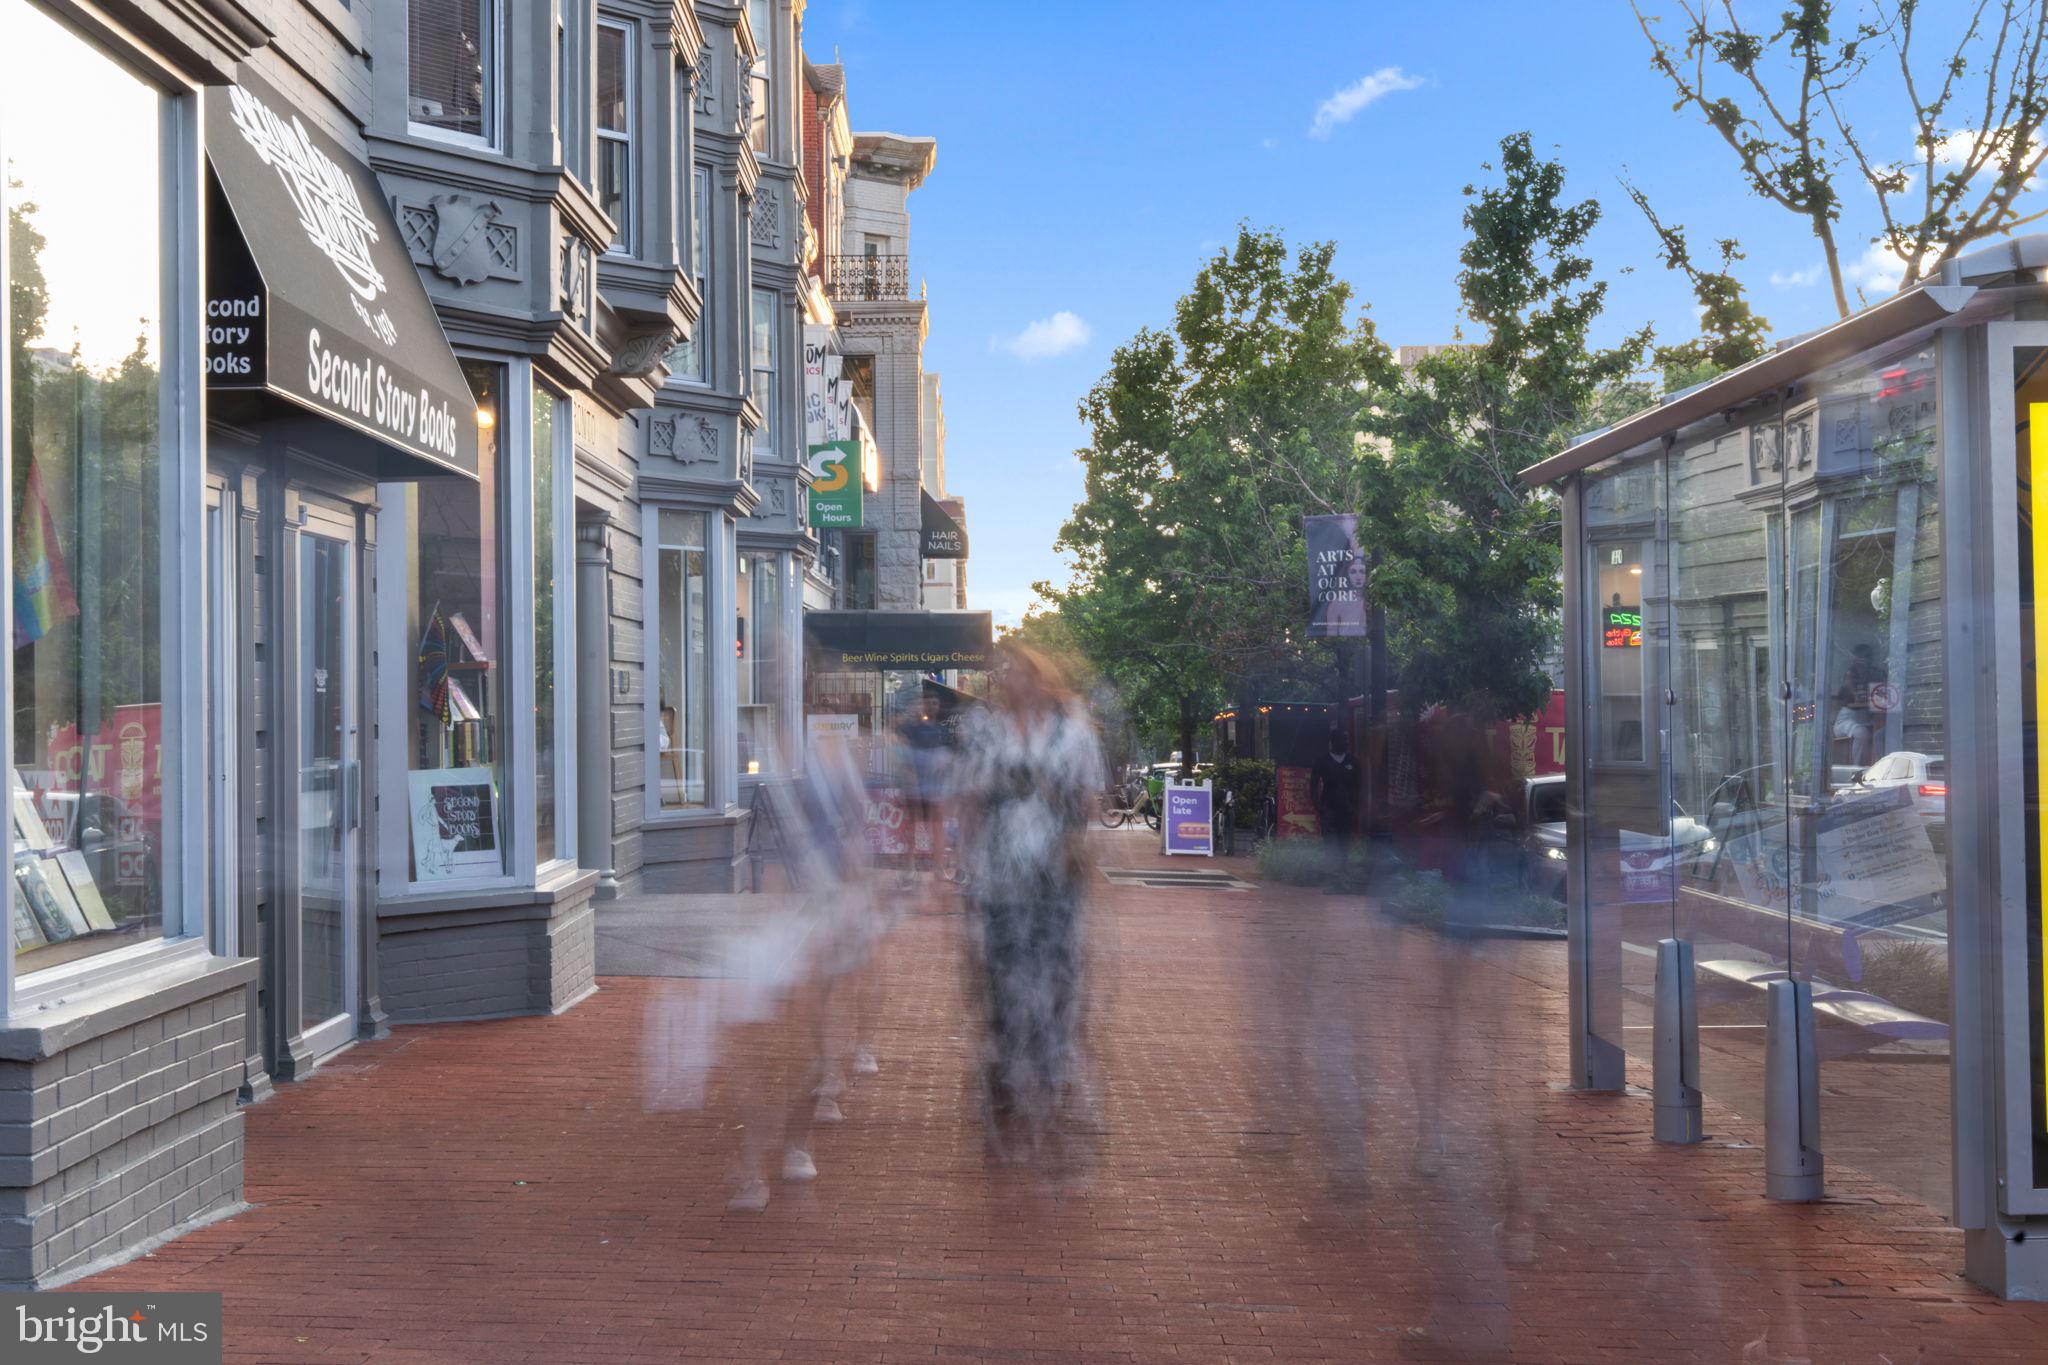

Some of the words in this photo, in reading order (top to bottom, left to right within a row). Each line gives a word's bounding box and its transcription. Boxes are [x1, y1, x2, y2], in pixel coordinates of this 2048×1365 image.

[207, 295, 260, 317] cond
[309, 327, 371, 418] Second
[376, 365, 416, 438] Story
[420, 388, 456, 458] Books
[816, 503, 843, 513] Open
[822, 514, 852, 522] Hours
[932, 531, 958, 541] HAIR
[928, 541, 961, 551] NAILS
[1316, 550, 1354, 563] ARTS
[1317, 564, 1337, 576] AT
[1318, 576, 1348, 590] OUR
[1318, 590, 1358, 602] CORE
[842, 652, 863, 663] Beer
[865, 653, 888, 662] Wine
[890, 653, 919, 665] Spirits
[921, 653, 949, 665] Cigars
[951, 653, 985, 662] Cheese
[1172, 796, 1198, 806] Open
[1173, 806, 1193, 815] late
